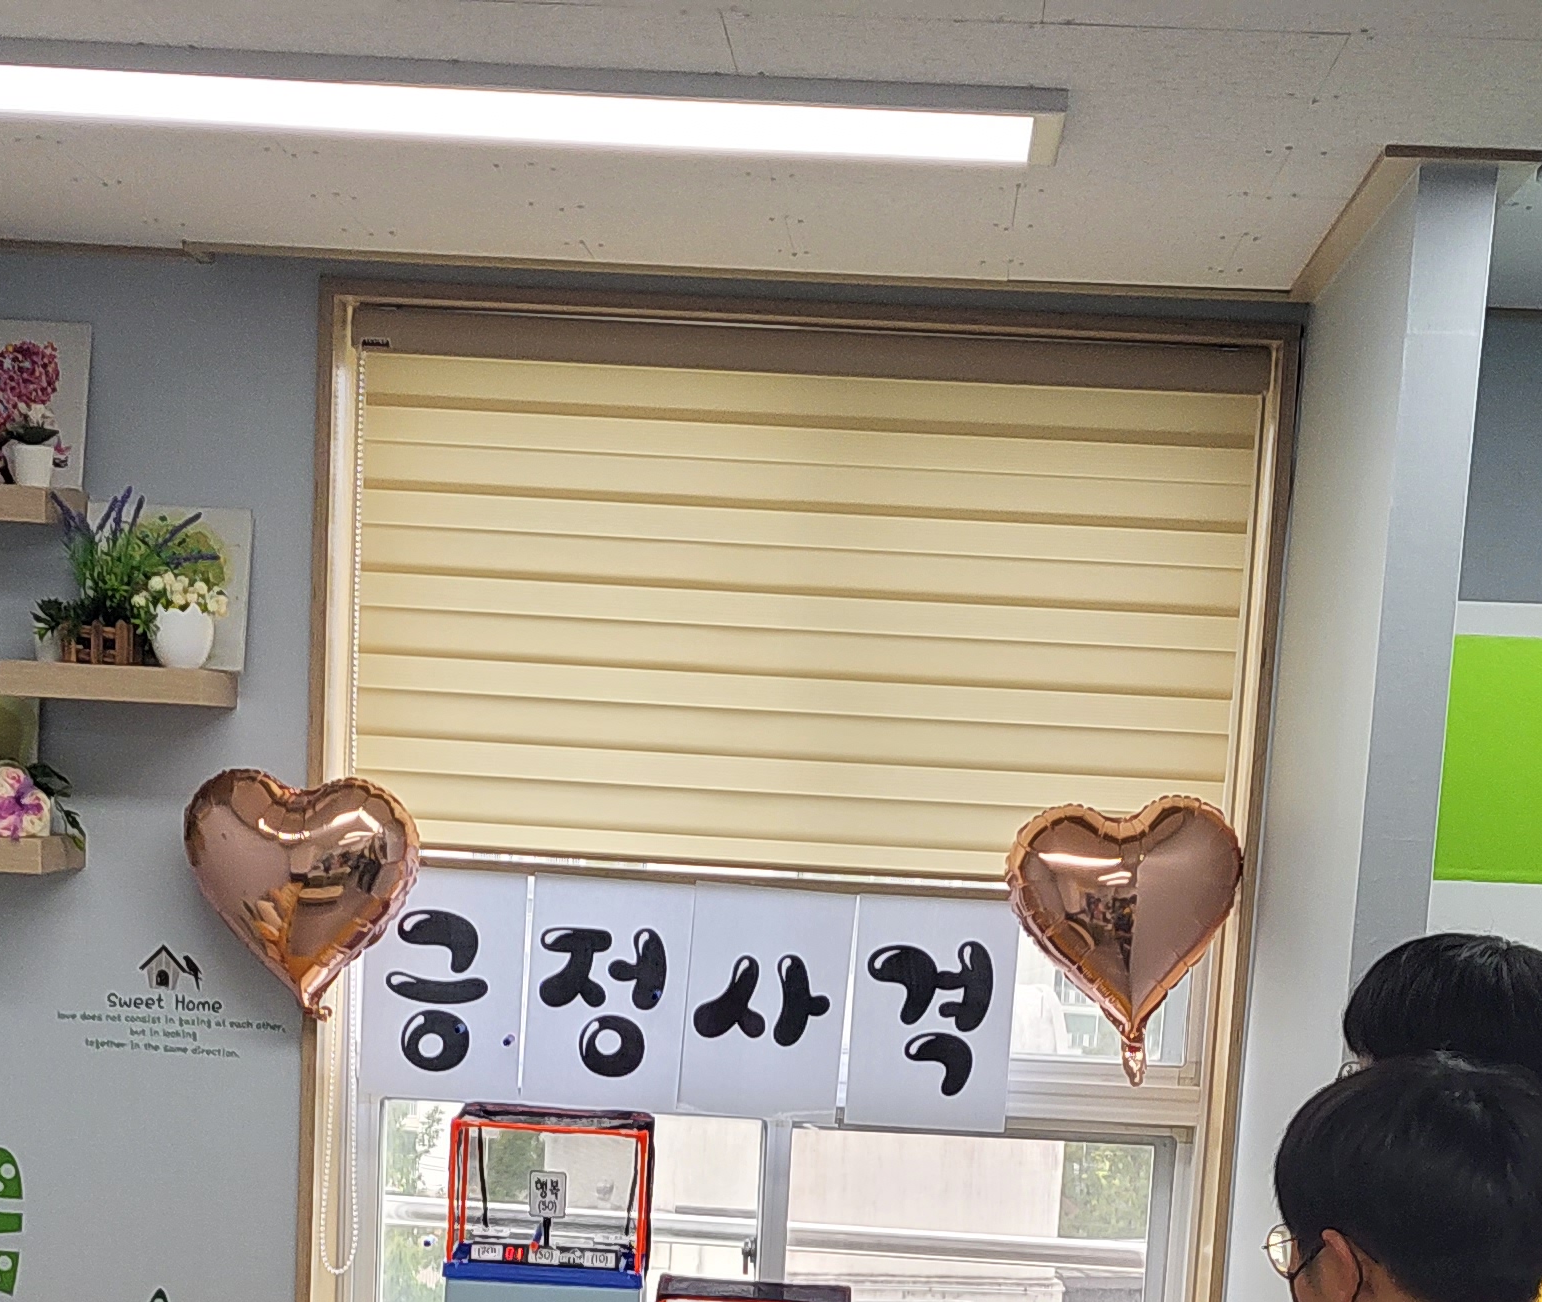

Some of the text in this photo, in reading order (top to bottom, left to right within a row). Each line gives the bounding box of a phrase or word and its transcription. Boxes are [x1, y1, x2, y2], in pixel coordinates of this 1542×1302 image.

[106, 991, 223, 1014] Sweet Home
[385, 908, 995, 1097] 긍정사격
[124, 1013, 161, 1025] consist
[534, 1176, 561, 1200] 행복
[590, 1252, 609, 1267] (10)
